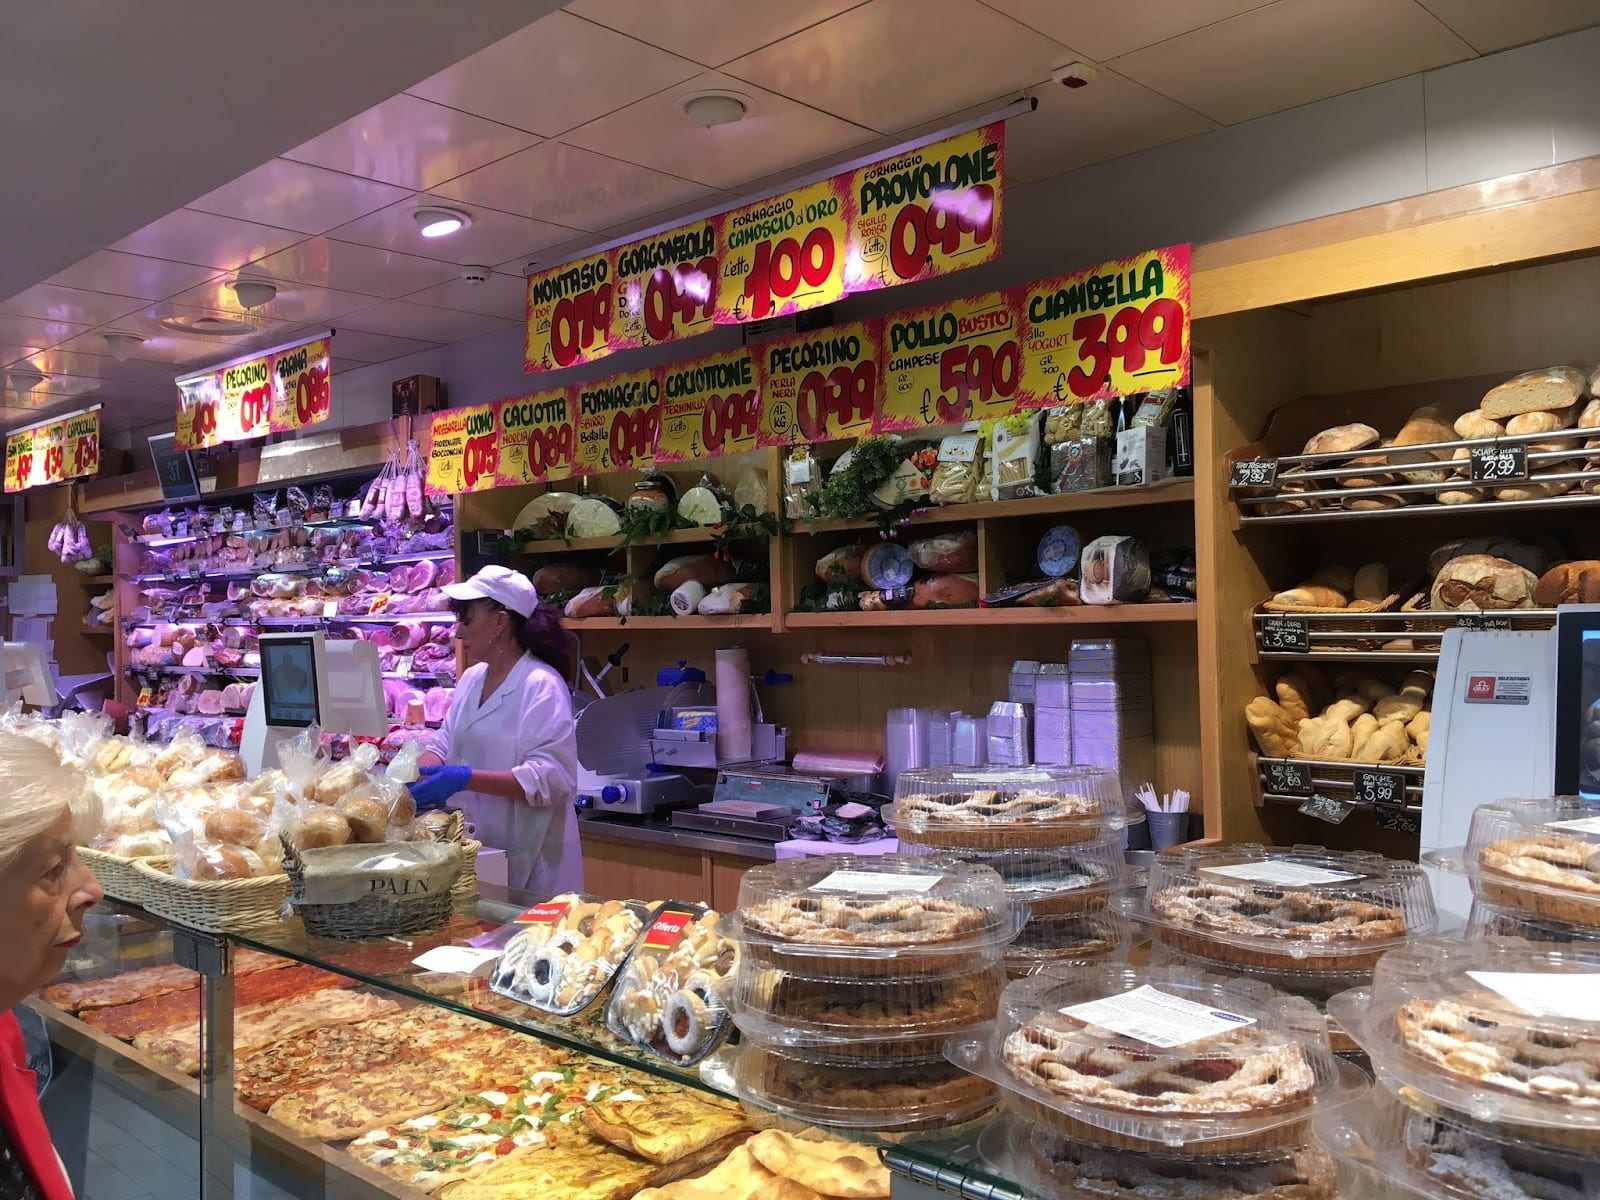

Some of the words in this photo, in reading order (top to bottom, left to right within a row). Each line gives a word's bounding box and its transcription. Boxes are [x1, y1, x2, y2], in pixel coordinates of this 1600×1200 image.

[864, 155, 922, 181] FORMAGGIO
[860, 143, 998, 215] PROVOLONE
[732, 198, 794, 228] FORMAGGIO
[857, 213, 887, 230] SIGILLO
[728, 210, 795, 250] CAMOSCIO
[861, 223, 887, 238] ROSSO
[617, 225, 715, 278] GORGONZOLA
[533, 258, 608, 307] MONTASIO
[1028, 259, 1164, 324] CIAMBELLA
[535, 304, 551, 319] DOP
[890, 312, 958, 354] POLLO
[1027, 327, 1045, 341] allo
[1028, 333, 1071, 352] YOGURT
[276, 348, 307, 378] GRANA
[770, 335, 860, 375] PECORINO
[888, 352, 940, 372] CAMPESE
[226, 362, 267, 390] PECORINO
[665, 357, 752, 398] CACIOTTONE
[1042, 365, 1060, 375] 700
[770, 376, 796, 388] PERLA
[581, 379, 659, 415] FORMAGGIO
[772, 388, 796, 399] NERA
[503, 396, 567, 428] CACIOTTA
[663, 399, 706, 416] TERMINILLO
[774, 404, 787, 415] AL
[466, 411, 494, 436] CUOMO
[167, 460, 181, 481] 37
[1238, 469, 1265, 486] 2,99
[1483, 459, 1516, 480] 2,99
[1363, 785, 1393, 802] 5,99
[370, 878, 431, 895] PAIN
[652, 920, 681, 933] Offerta
